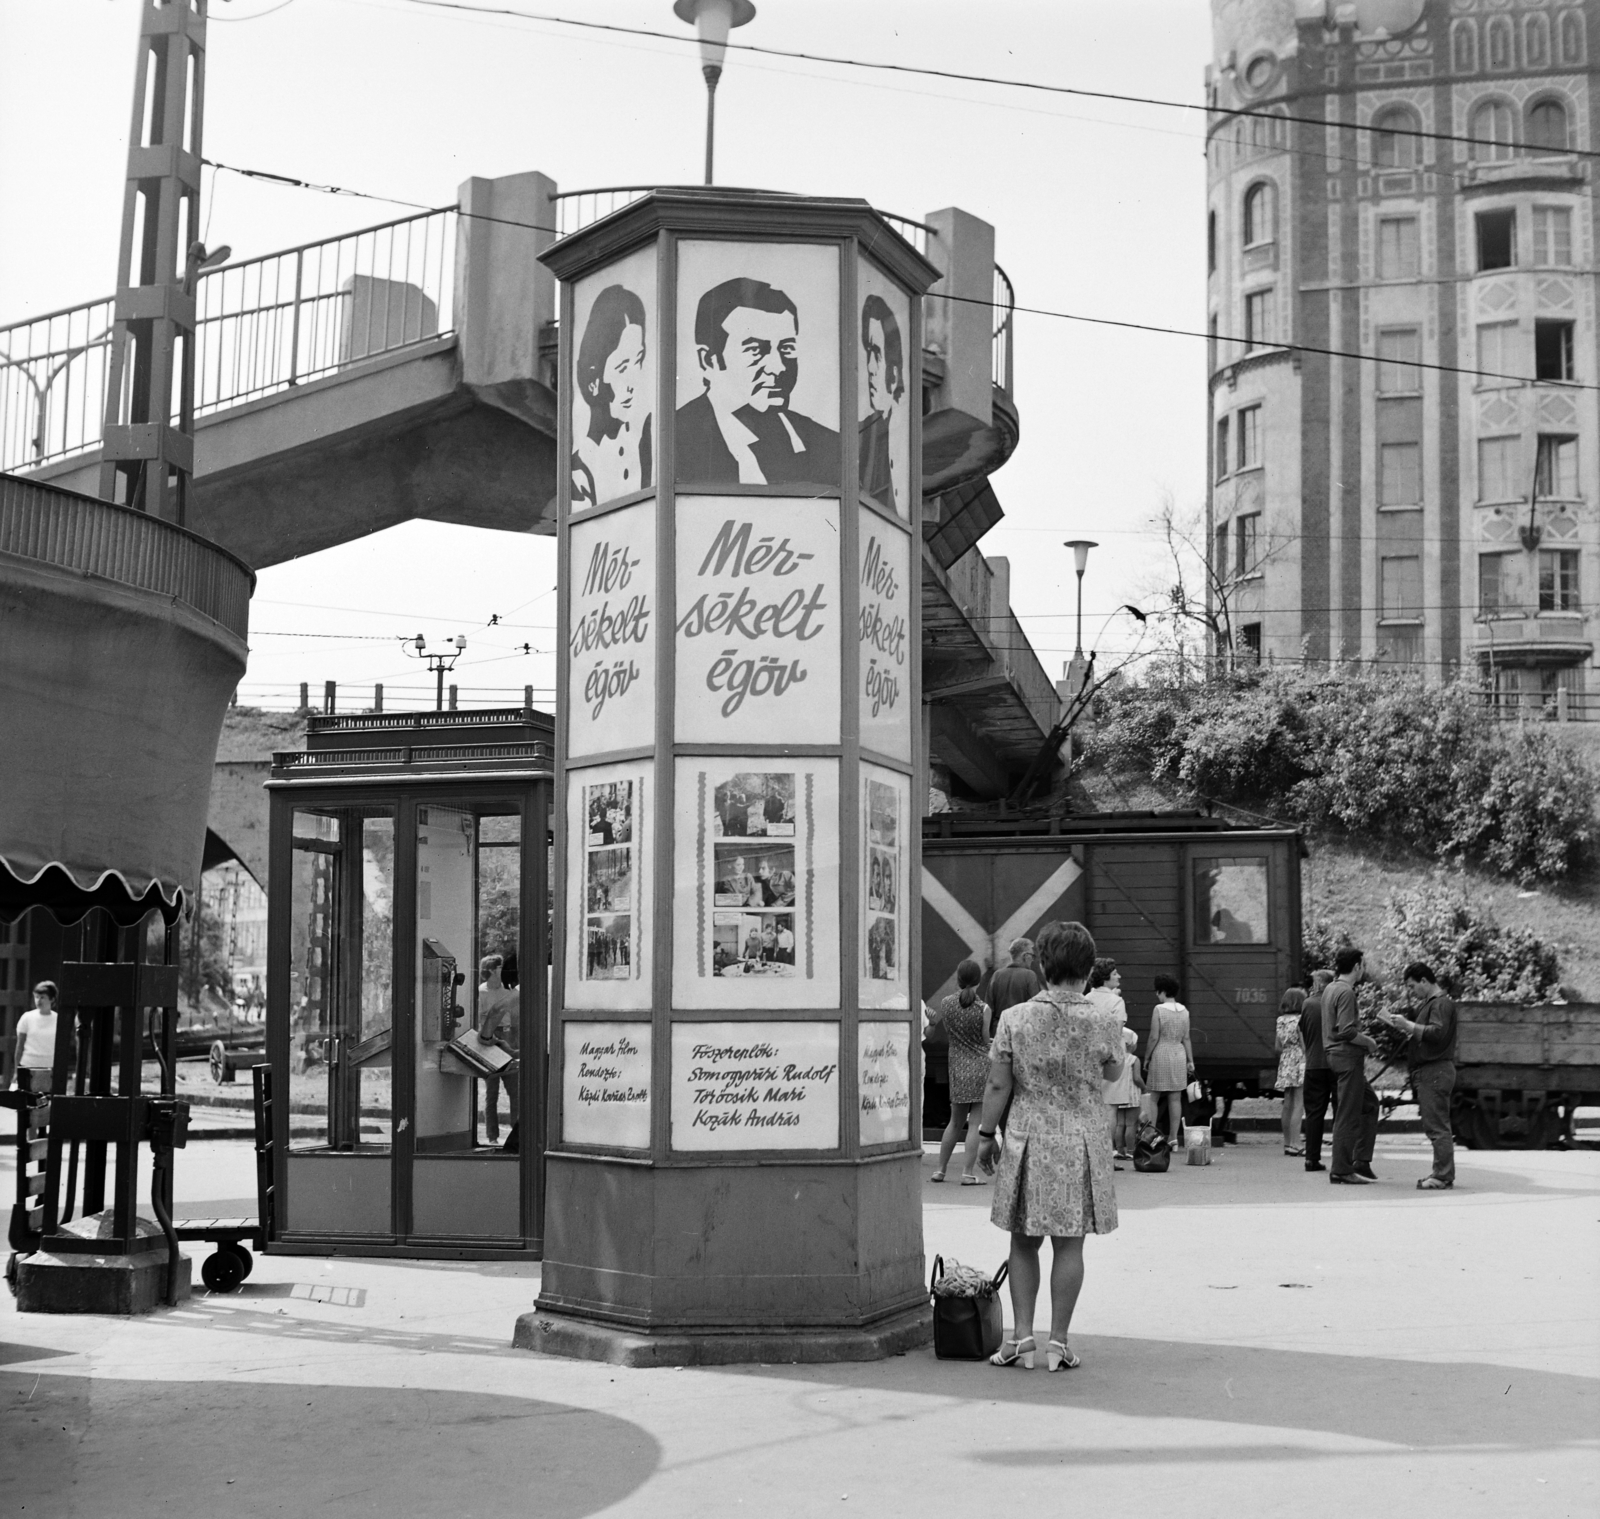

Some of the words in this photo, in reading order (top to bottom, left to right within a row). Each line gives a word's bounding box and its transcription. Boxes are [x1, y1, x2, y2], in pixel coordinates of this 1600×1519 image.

[582, 541, 640, 597] Mér-
[697, 519, 815, 578] Mér-
[569, 595, 651, 658] sékelt
[676, 583, 828, 641] sékelt
[584, 659, 640, 721] égöv
[705, 649, 808, 718] égöv
[1234, 987, 1268, 1003] 7036
[687, 1066, 780, 1088] Somogyvári
[782, 1063, 837, 1084] Rudolf
[762, 1086, 806, 1103] Mari
[692, 1109, 742, 1131] Kozák
[744, 1108, 800, 1127] András
